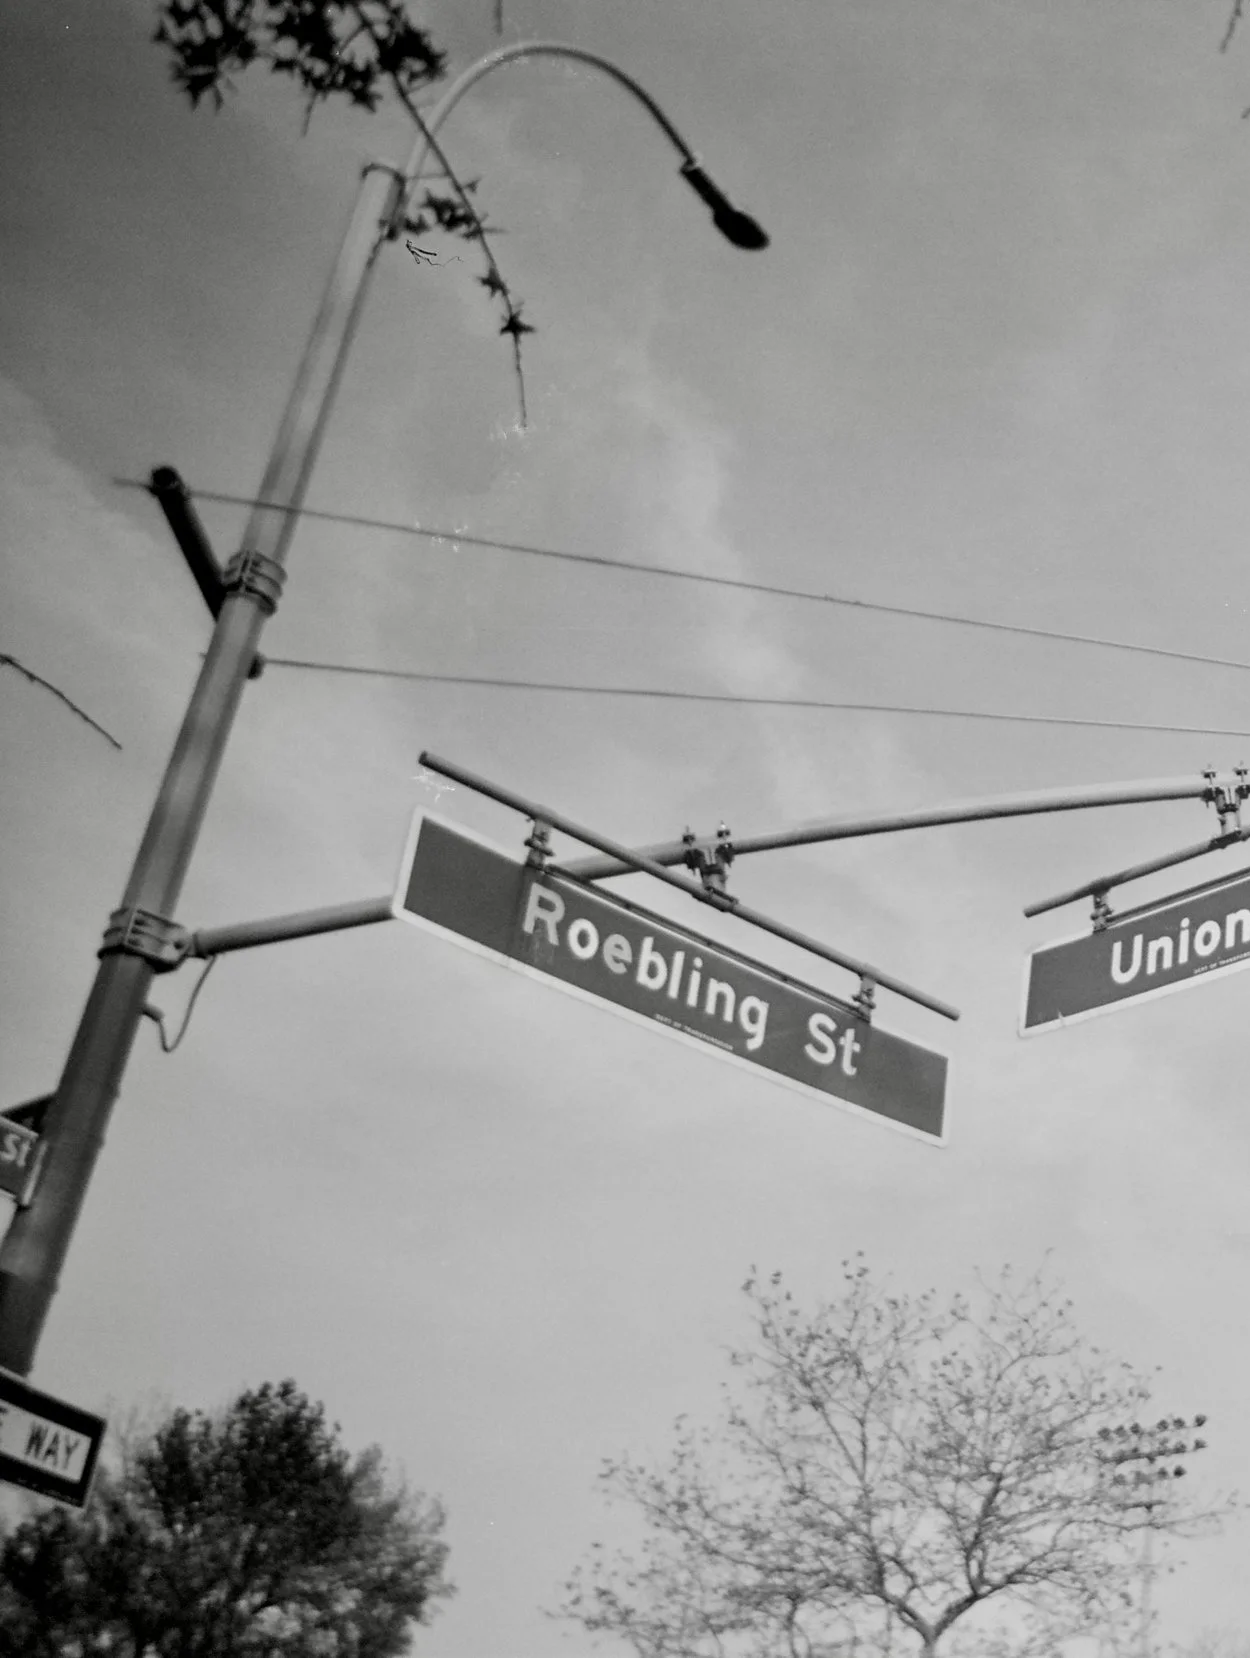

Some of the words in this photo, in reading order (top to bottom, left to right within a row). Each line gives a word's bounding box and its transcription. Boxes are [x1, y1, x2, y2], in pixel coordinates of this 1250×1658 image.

[524, 884, 770, 1051] Roebling
[806, 1012, 861, 1077] St
[25, 1421, 80, 1470] WAY
